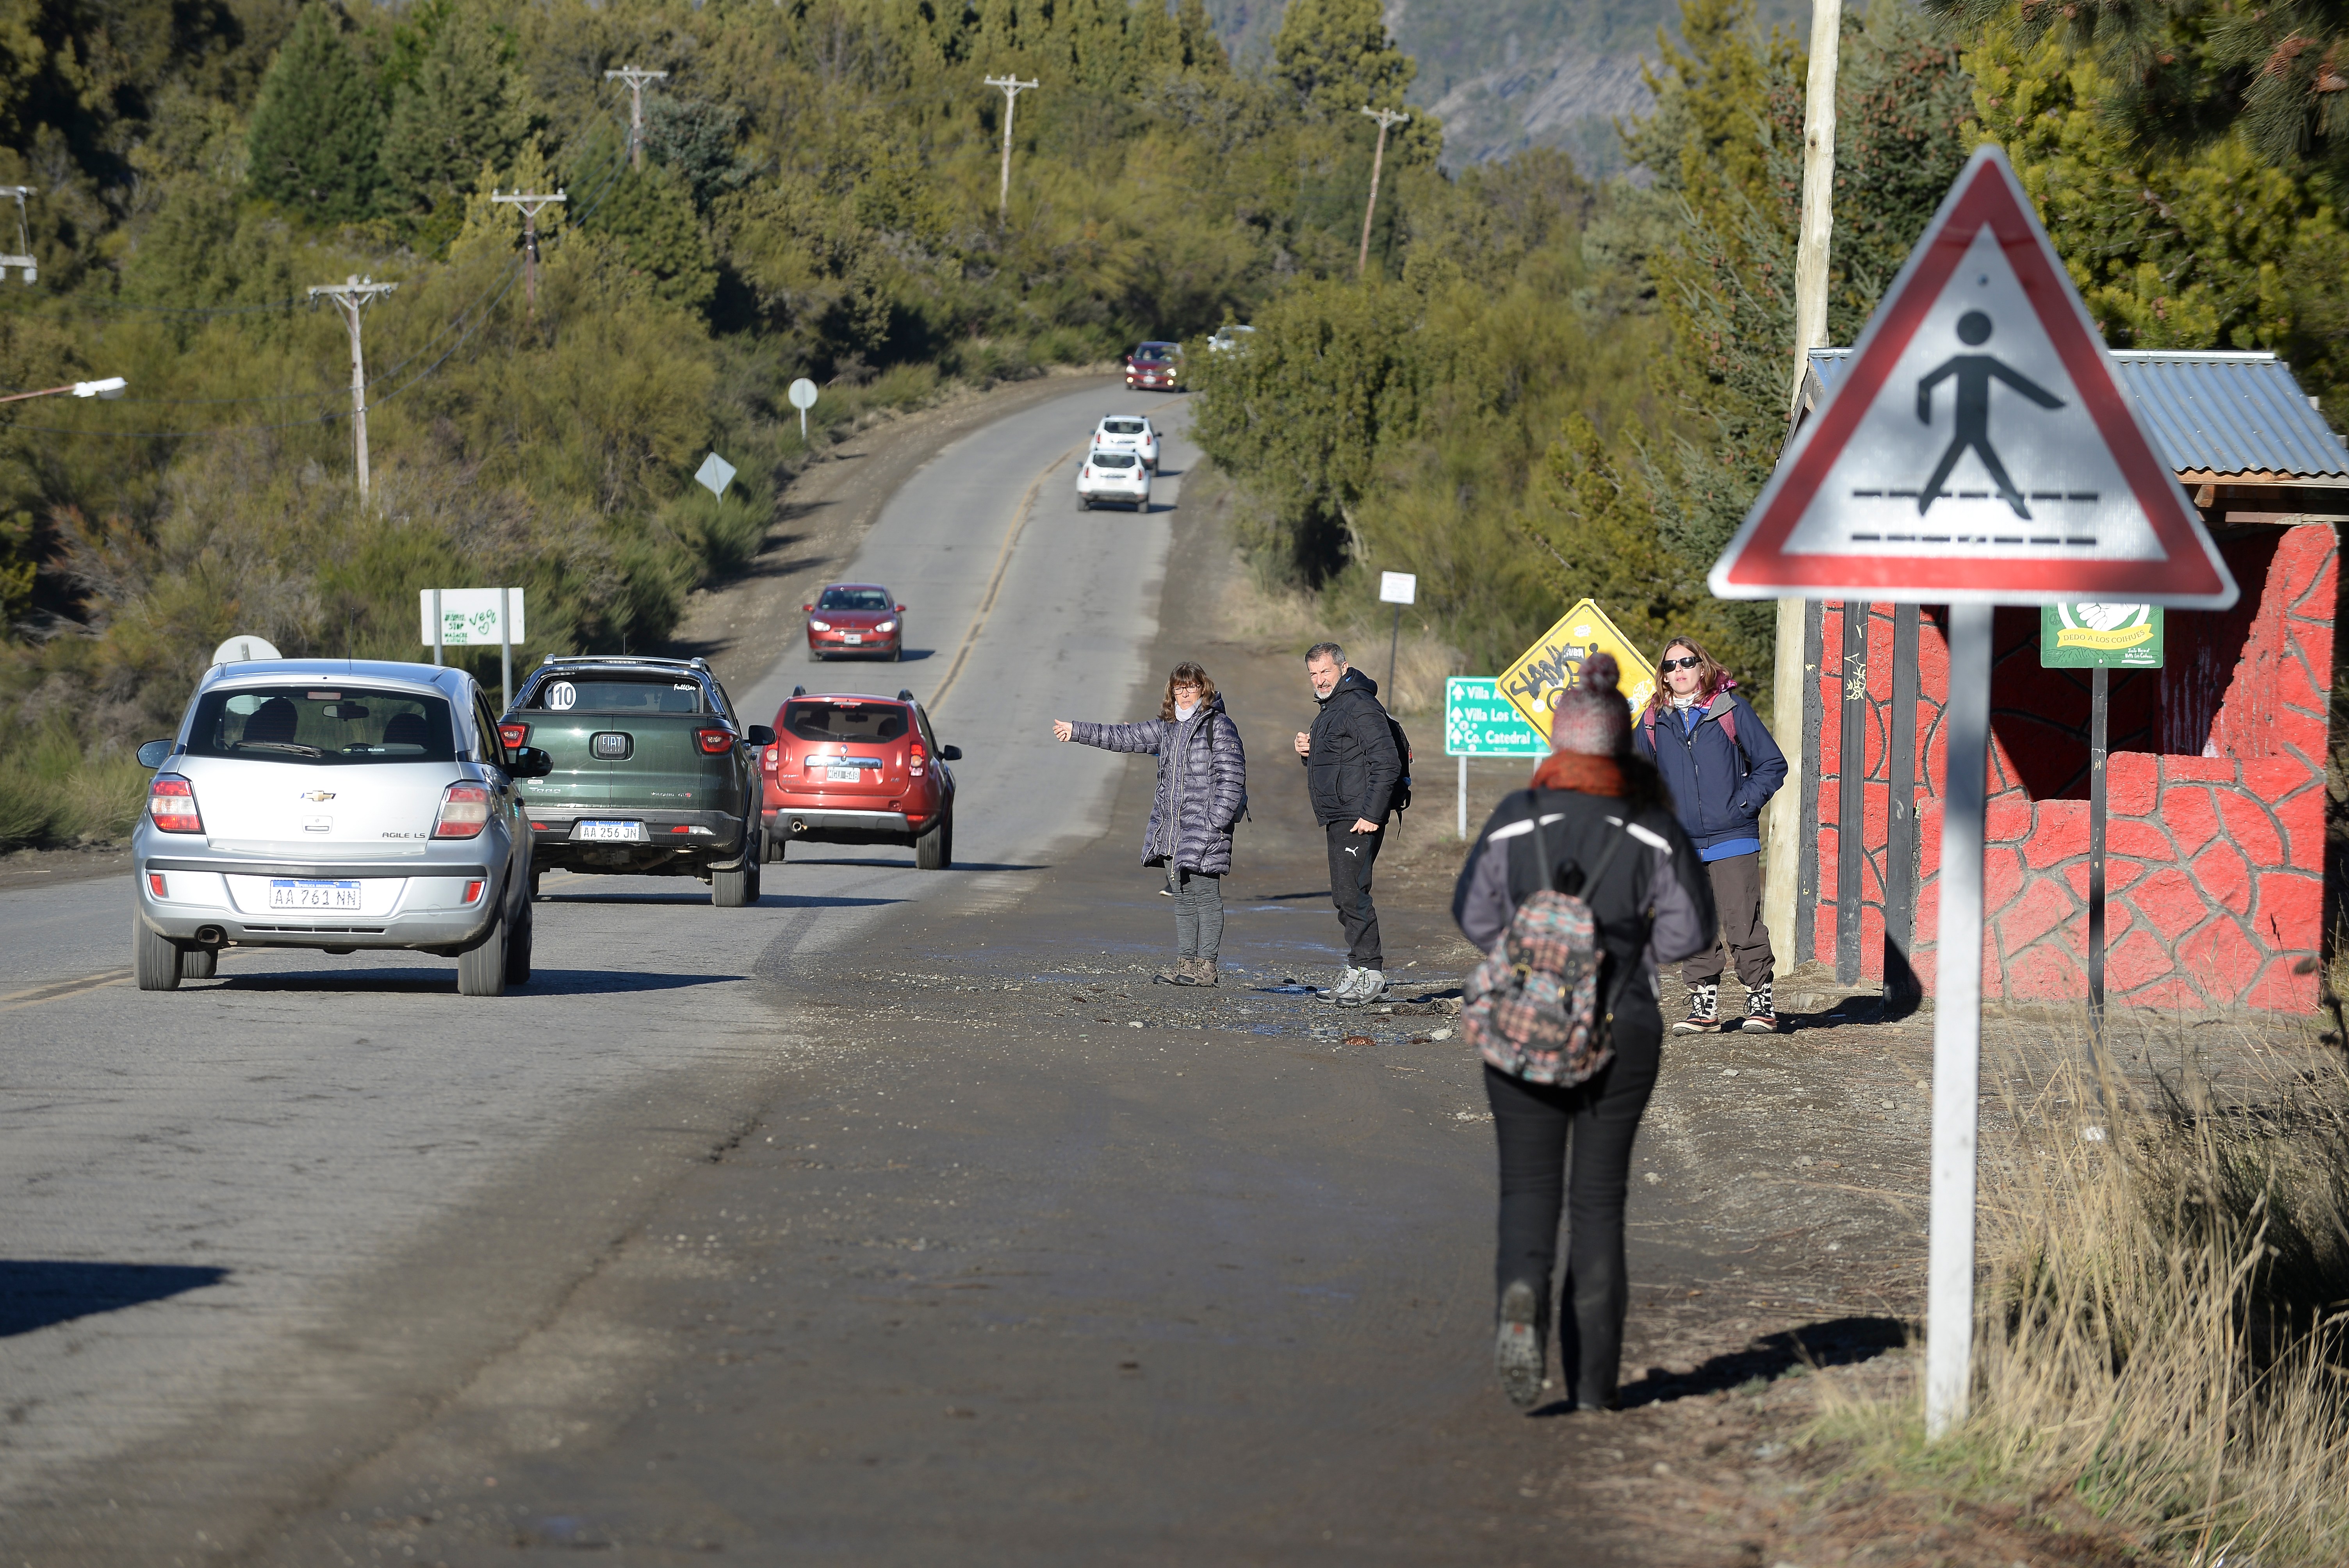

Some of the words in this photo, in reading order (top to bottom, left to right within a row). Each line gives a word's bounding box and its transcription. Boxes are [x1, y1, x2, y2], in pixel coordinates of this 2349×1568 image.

[2111, 629, 2145, 643] COIHUES
[548, 686, 574, 706] 110
[1466, 686, 1490, 700] Villa
[1464, 707, 1488, 722] Villa
[1490, 708, 1509, 722] Los
[602, 736, 622, 752] FIAT
[1485, 730, 1530, 745] Catedral
[845, 772, 859, 780] 548
[584, 827, 596, 837] AA
[600, 828, 619, 838] 256
[624, 828, 636, 838] JN
[275, 889, 293, 904] AA
[301, 889, 329, 905] 761
[337, 891, 355, 905] NN
